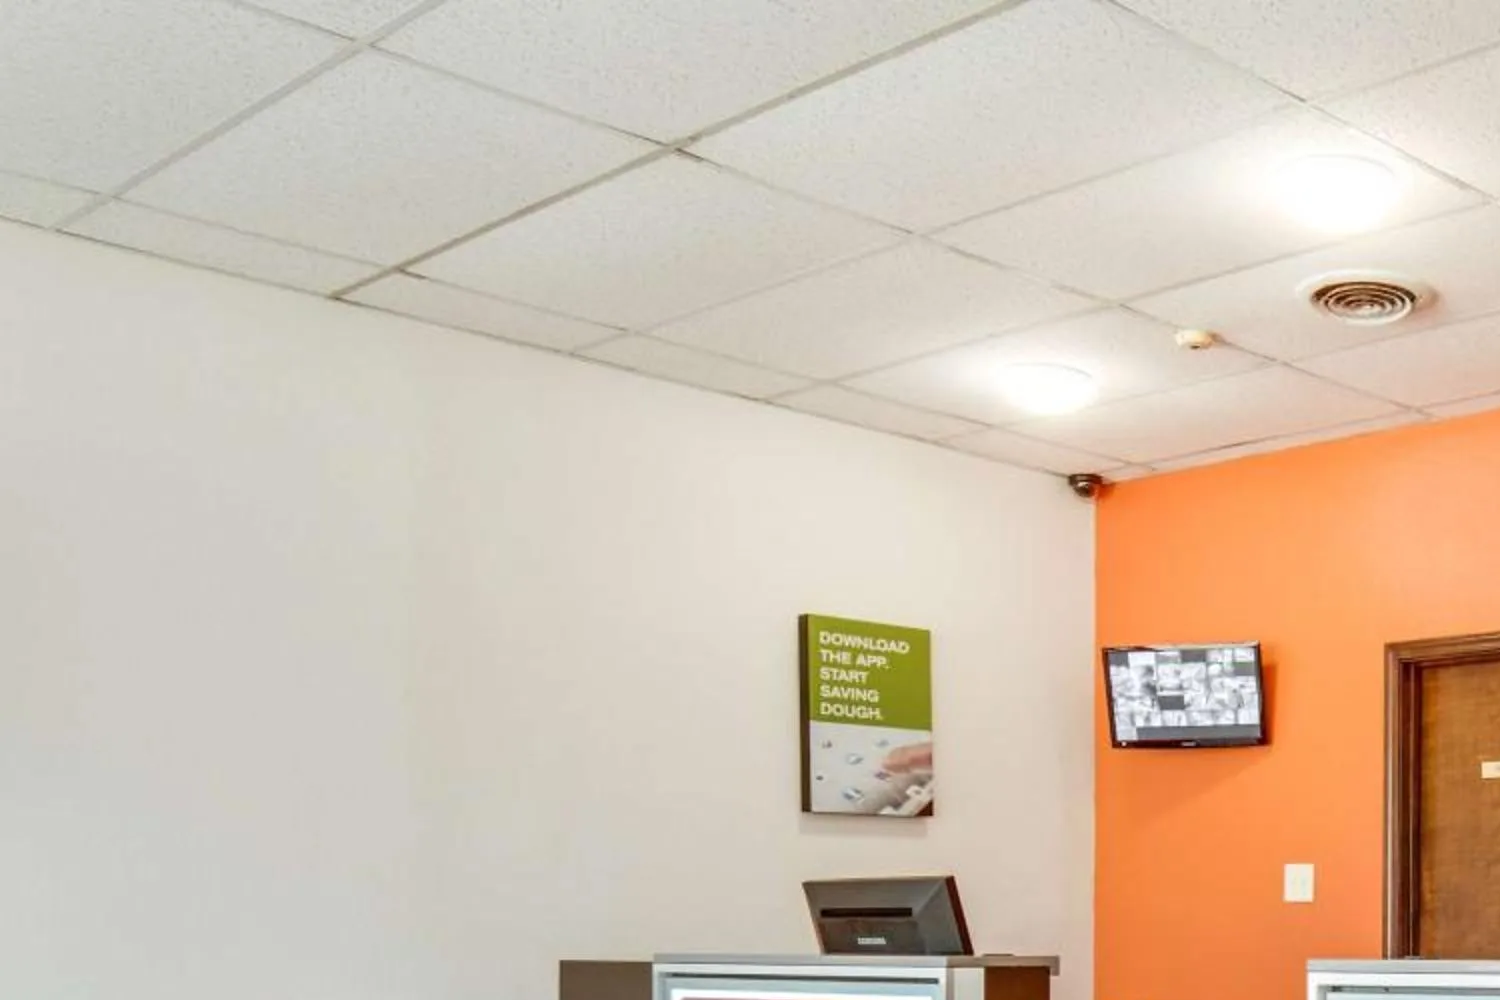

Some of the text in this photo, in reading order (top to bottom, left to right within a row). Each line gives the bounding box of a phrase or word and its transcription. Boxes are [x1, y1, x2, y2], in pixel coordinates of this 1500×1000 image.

[819, 631, 910, 653] DOWNLOAD
[820, 649, 851, 665] THE
[820, 667, 868, 684] START
[820, 685, 879, 702] SAVING
